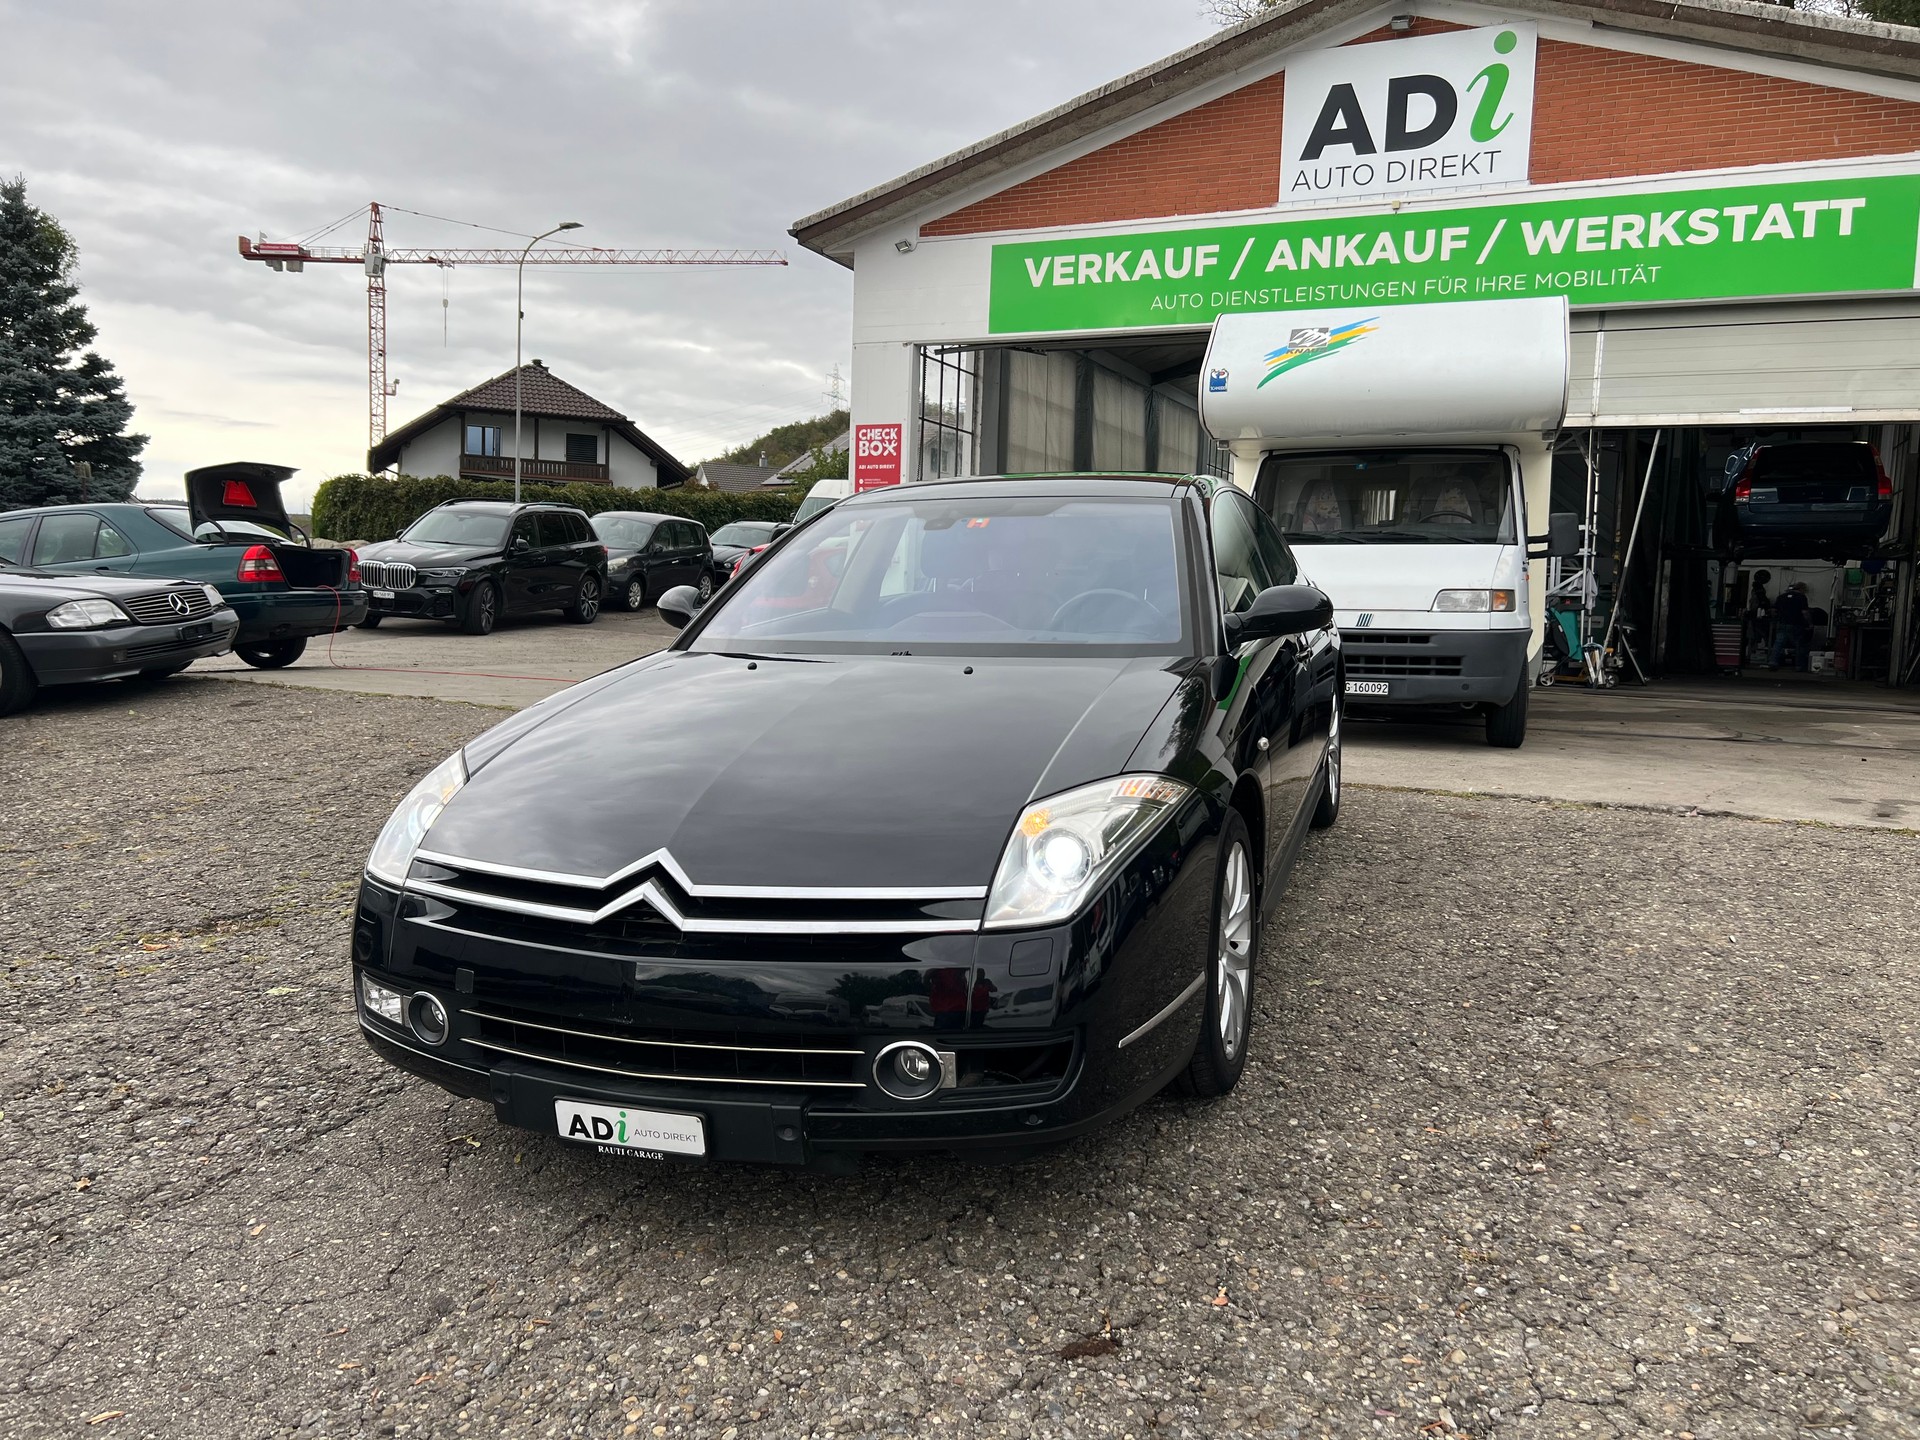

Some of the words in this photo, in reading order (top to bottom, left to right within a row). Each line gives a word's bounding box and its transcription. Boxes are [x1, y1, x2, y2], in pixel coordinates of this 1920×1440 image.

[1298, 30, 1518, 161] ADi
[1290, 163, 1375, 192] AUTO
[1386, 150, 1502, 184] DIREKT
[1023, 244, 1220, 288] VERKAUF
[1264, 226, 1470, 273] ANKAUF
[1520, 197, 1867, 256] WERKSTATT
[1150, 292, 1204, 311] AUTO
[1210, 280, 1416, 307] DIENSTLEISTUNGEN
[1424, 276, 1467, 296] FÜR
[1475, 273, 1527, 293] IHRE
[1534, 263, 1662, 290] MOBILITÄT
[858, 428, 898, 440] CHECK
[858, 440, 898, 457] BOX
[568, 1111, 631, 1144] ADi
[634, 1128, 661, 1139] AUTO
[663, 1131, 698, 1143] DIREKT
[598, 1145, 625, 1156] RAUTI
[626, 1148, 665, 1161] GARAGE
